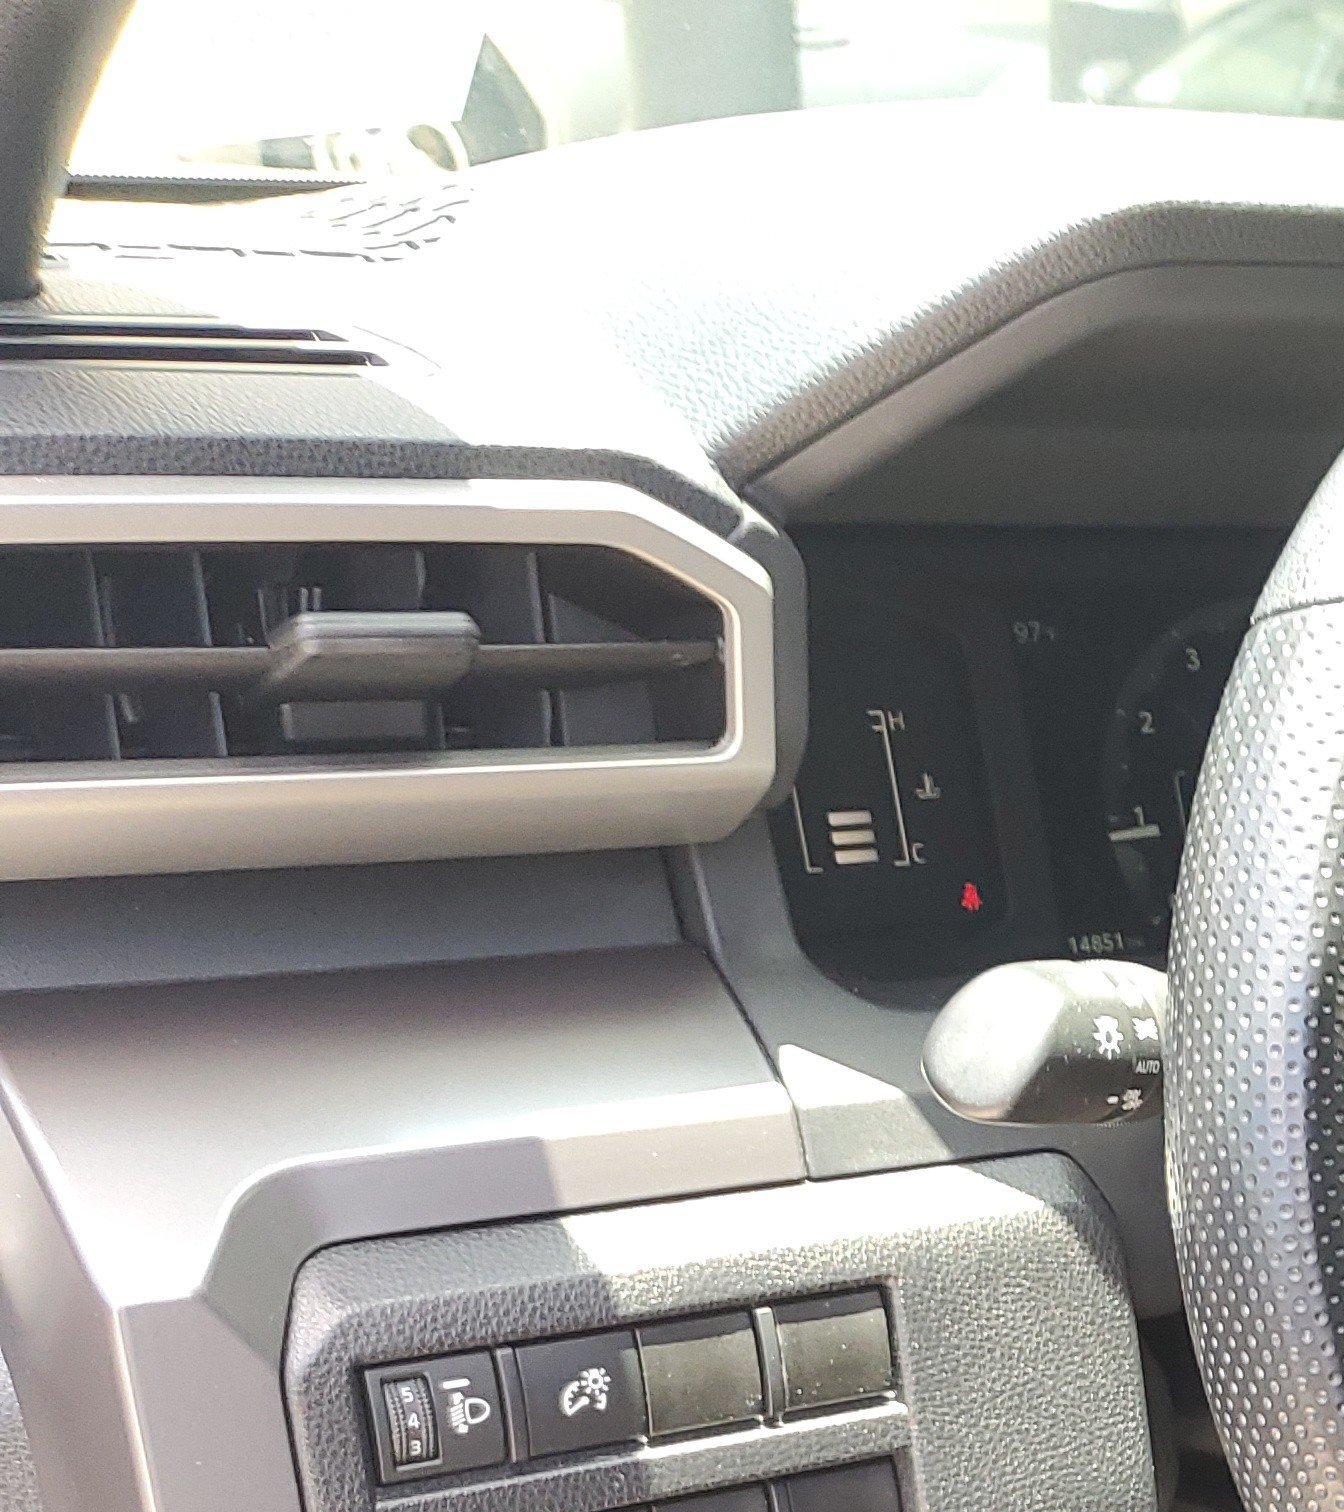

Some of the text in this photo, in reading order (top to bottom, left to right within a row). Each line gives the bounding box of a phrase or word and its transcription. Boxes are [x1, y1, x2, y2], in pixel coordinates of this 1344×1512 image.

[1185, 649, 1200, 672] 3
[889, 711, 904, 731] H
[1139, 711, 1155, 735] 2
[1133, 806, 1147, 826] 1
[1135, 1059, 1160, 1075] AUTO
[401, 1387, 414, 1402] 5
[408, 1413, 420, 1429] 4
[410, 1440, 422, 1457] 3
